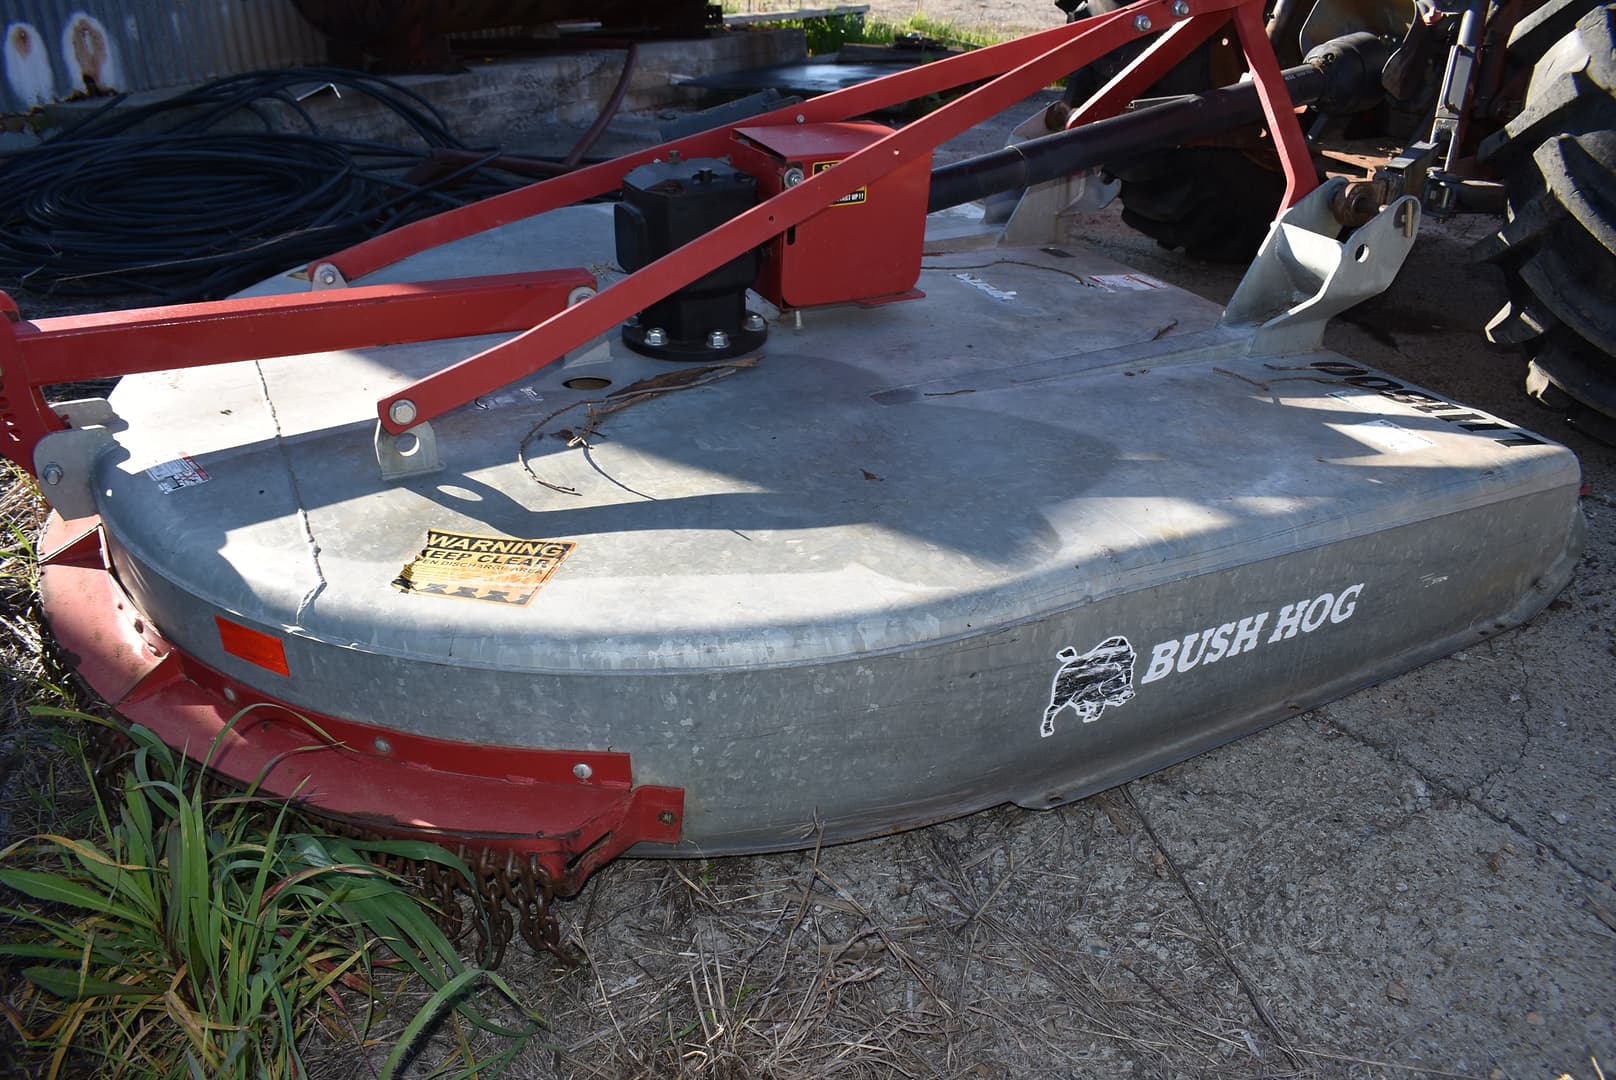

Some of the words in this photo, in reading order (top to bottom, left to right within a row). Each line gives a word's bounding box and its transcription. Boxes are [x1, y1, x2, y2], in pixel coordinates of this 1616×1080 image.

[428, 533, 564, 557] WARNING
[477, 554, 551, 568] CLEAR
[1141, 612, 1269, 684] BUSH
[1267, 583, 1365, 644] HOG
